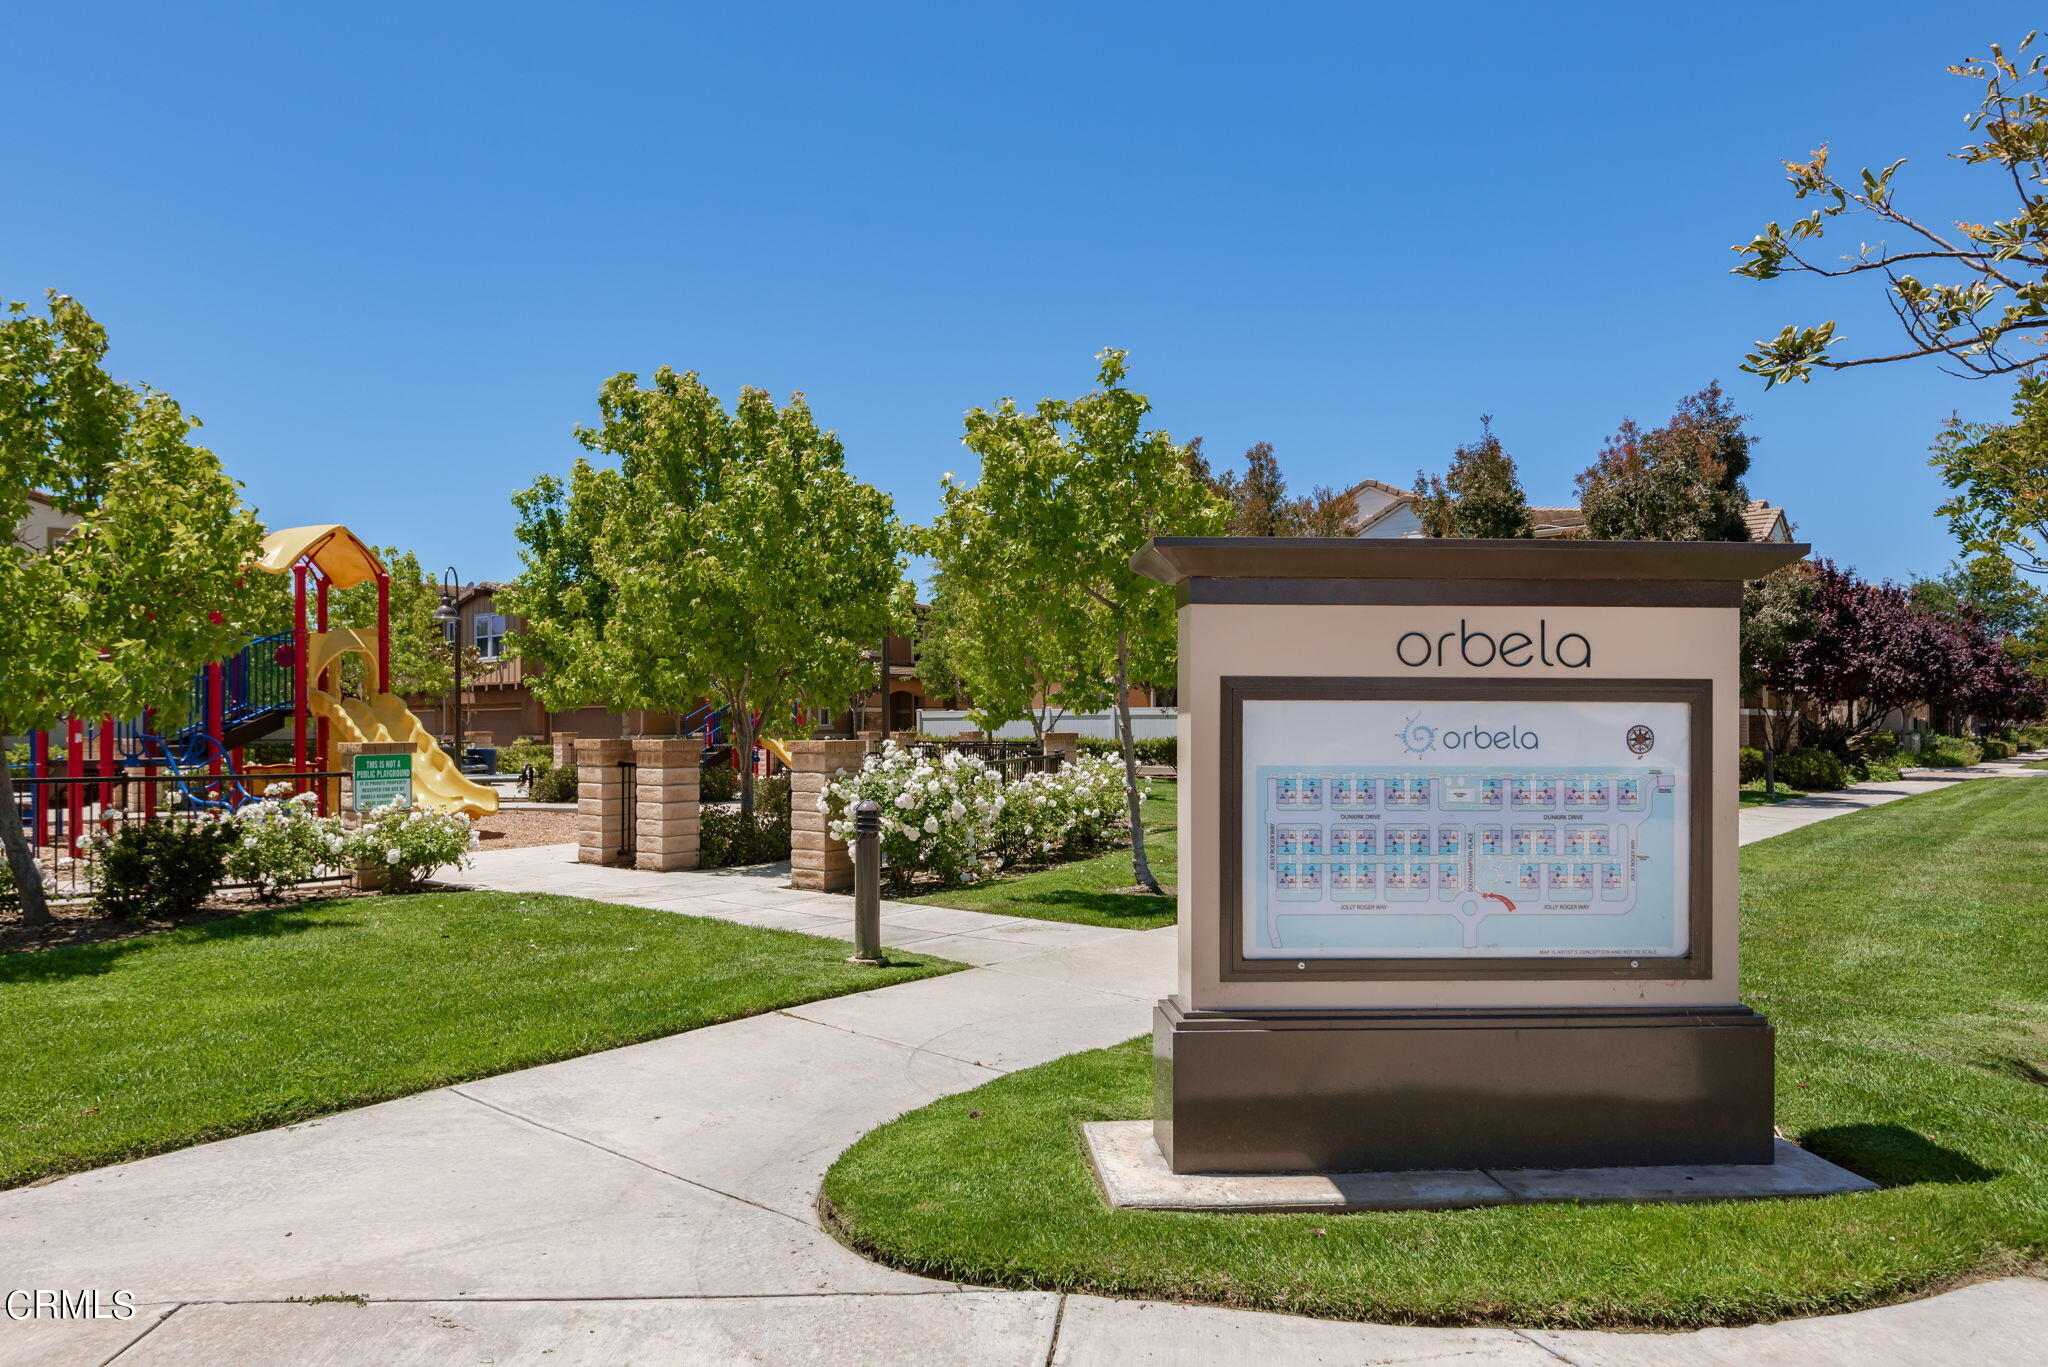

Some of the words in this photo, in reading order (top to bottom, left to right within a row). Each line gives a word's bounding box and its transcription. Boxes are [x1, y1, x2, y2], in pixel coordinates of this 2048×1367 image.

[1396, 618, 1591, 668] orbela
[1443, 724, 1539, 750] orbela
[366, 760, 378, 769] THIS
[379, 760, 385, 769] IS
[386, 760, 396, 768] NOT
[397, 760, 401, 768] A
[356, 770, 376, 779] PUBLIC
[377, 769, 411, 778] PLAYGROUND
